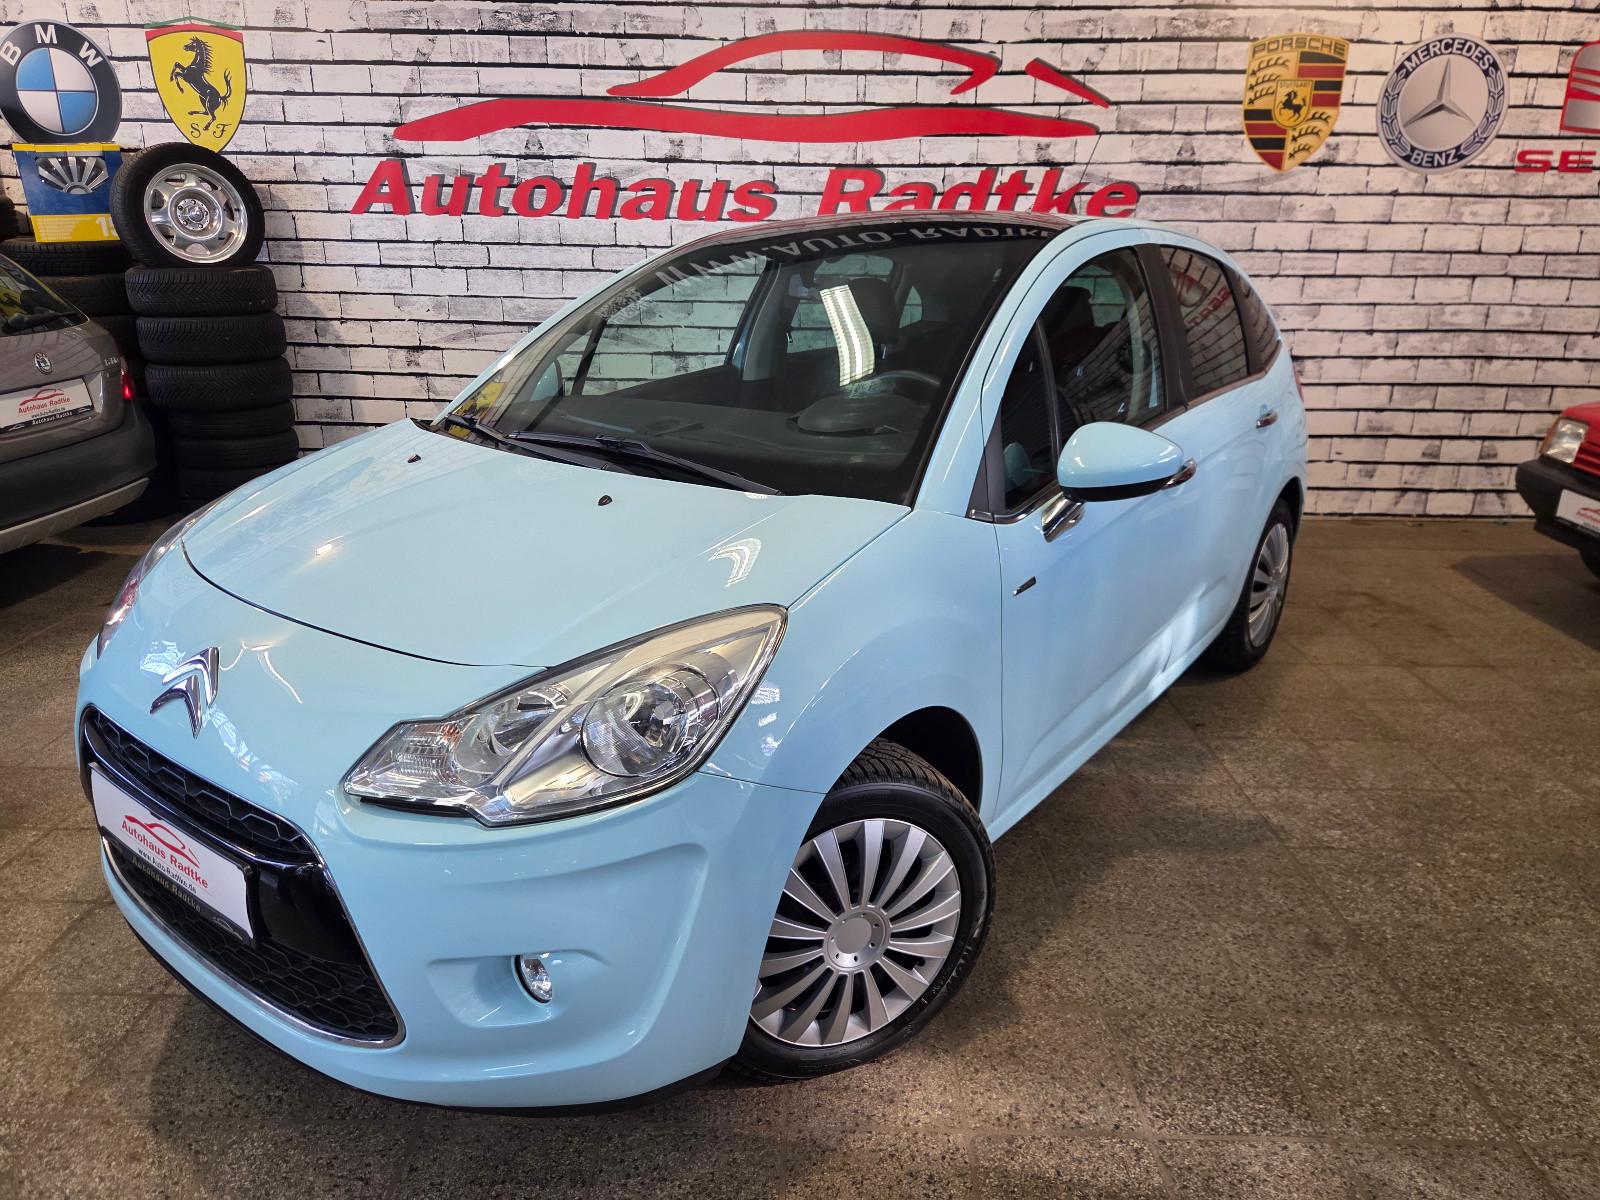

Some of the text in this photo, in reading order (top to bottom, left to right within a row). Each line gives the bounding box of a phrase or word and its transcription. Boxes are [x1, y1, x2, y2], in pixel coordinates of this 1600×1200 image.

[0, 24, 103, 66] BMW
[1252, 36, 1346, 59] PORSCHE
[1405, 38, 1493, 72] MERCEDES
[1410, 150, 1460, 168] BENZ
[351, 158, 1139, 222] Autohaus Radtke
[18, 398, 70, 414] Autohaus Radtke
[122, 819, 209, 889] Autohaus Radtke
[132, 856, 201, 912] Autohaus Radtke
